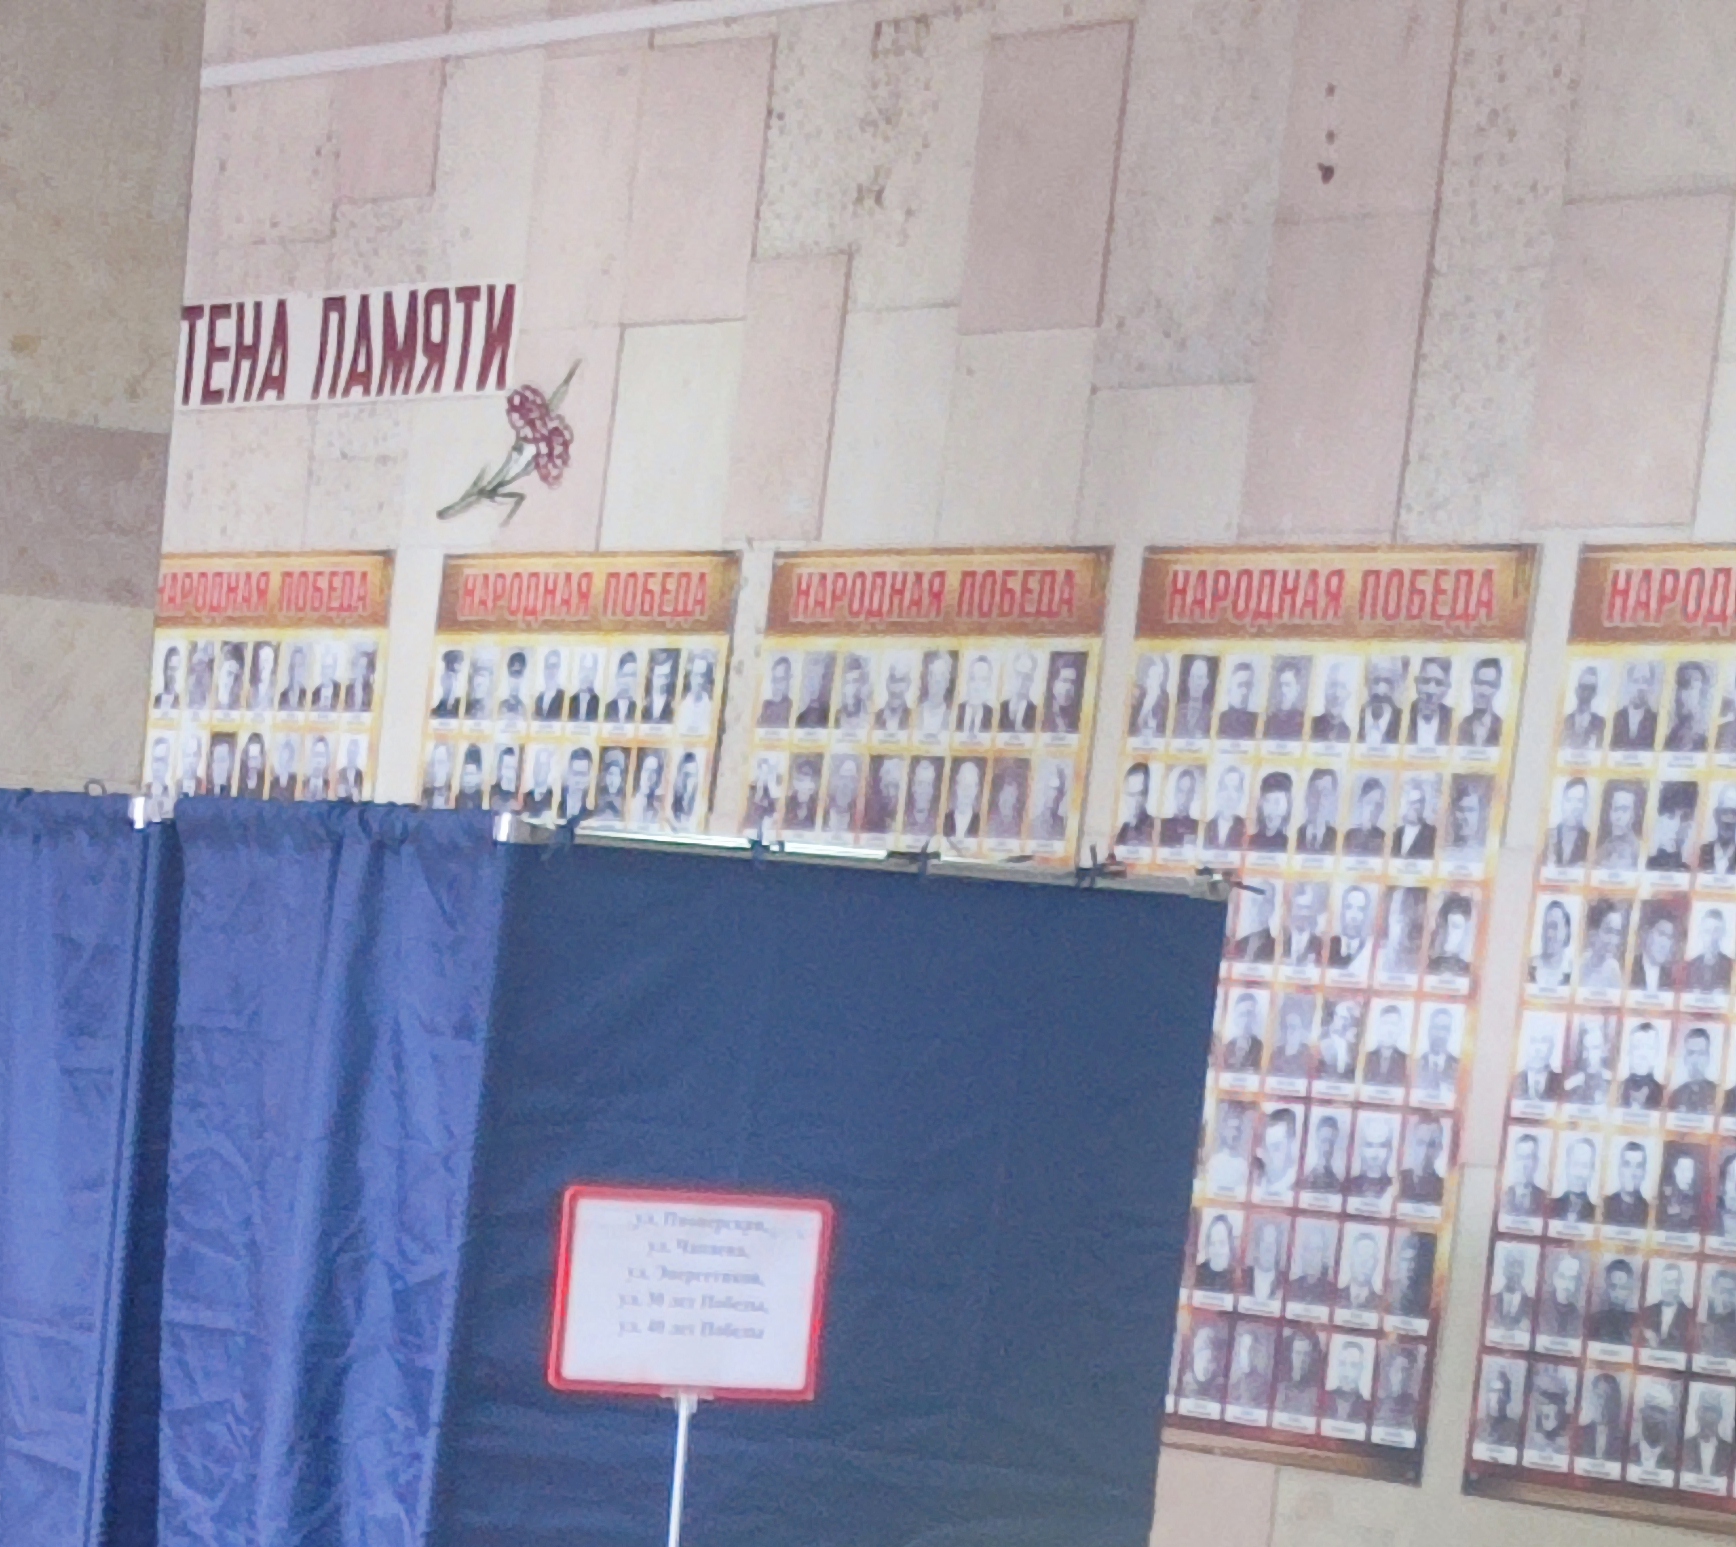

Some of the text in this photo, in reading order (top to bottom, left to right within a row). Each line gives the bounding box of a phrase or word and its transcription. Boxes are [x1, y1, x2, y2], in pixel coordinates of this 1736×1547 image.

[181, 283, 516, 406] ТЕНА ПАМЯТИ
[278, 570, 369, 615] ПОБЕДА
[458, 571, 708, 619] НАРОДНАЯ ПОБЕДА
[791, 569, 1076, 620] НАРОДНАЯ ПОБЕДА
[1168, 567, 1495, 629] НАРОДНАЯ ПОБЕДА
